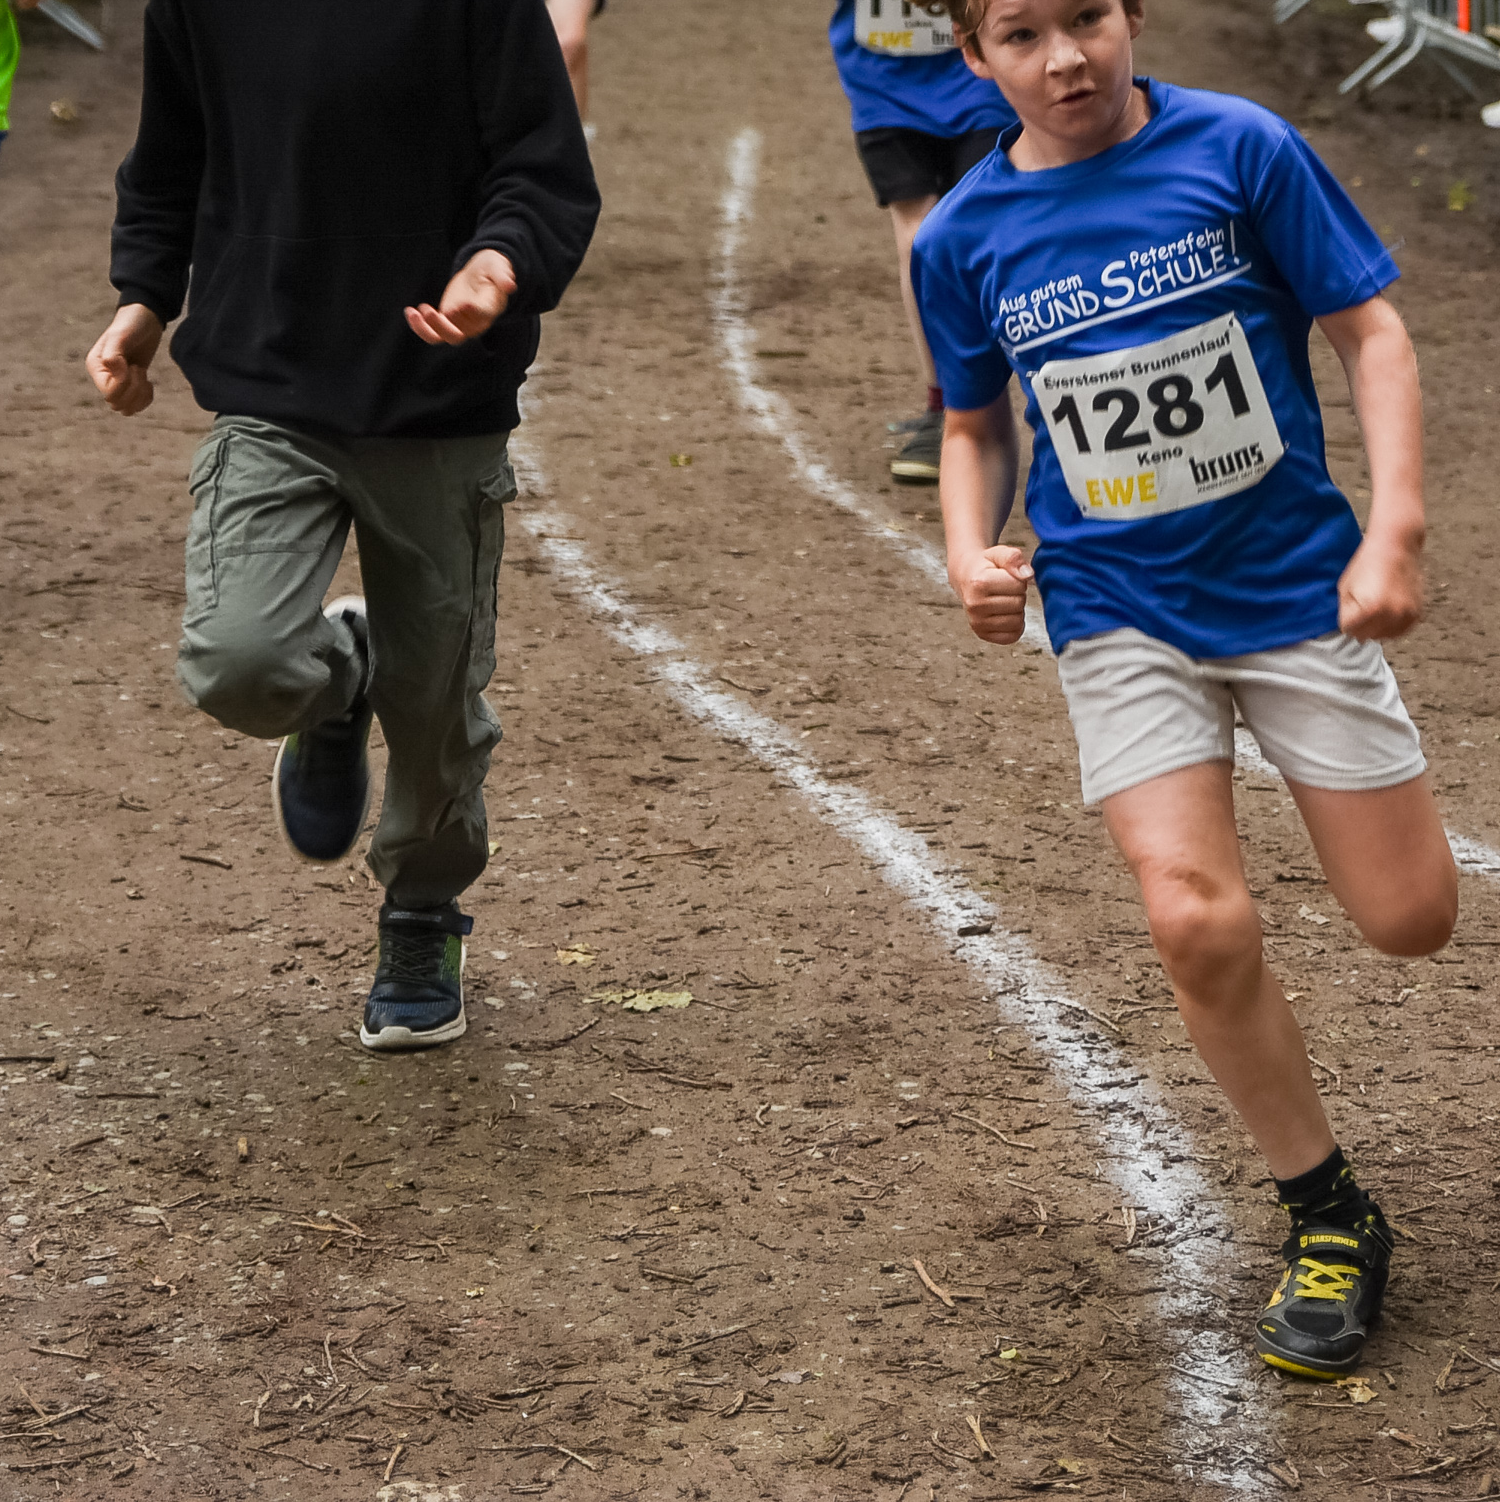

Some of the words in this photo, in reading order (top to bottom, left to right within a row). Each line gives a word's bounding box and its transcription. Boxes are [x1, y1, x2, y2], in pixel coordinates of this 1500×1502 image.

[1129, 227, 1225, 270] Petersfehn
[999, 293, 1026, 317] Aus
[1030, 274, 1082, 308] gutem
[1043, 367, 1127, 390] Everstener
[1130, 330, 1231, 376] Brunnenlauf
[1051, 351, 1250, 455] 1281
[1137, 446, 1183, 467] Keno
[1188, 442, 1264, 486] bruns
[1085, 472, 1158, 507] EWE
[1309, 1234, 1359, 1248] TRANSFORMERS
